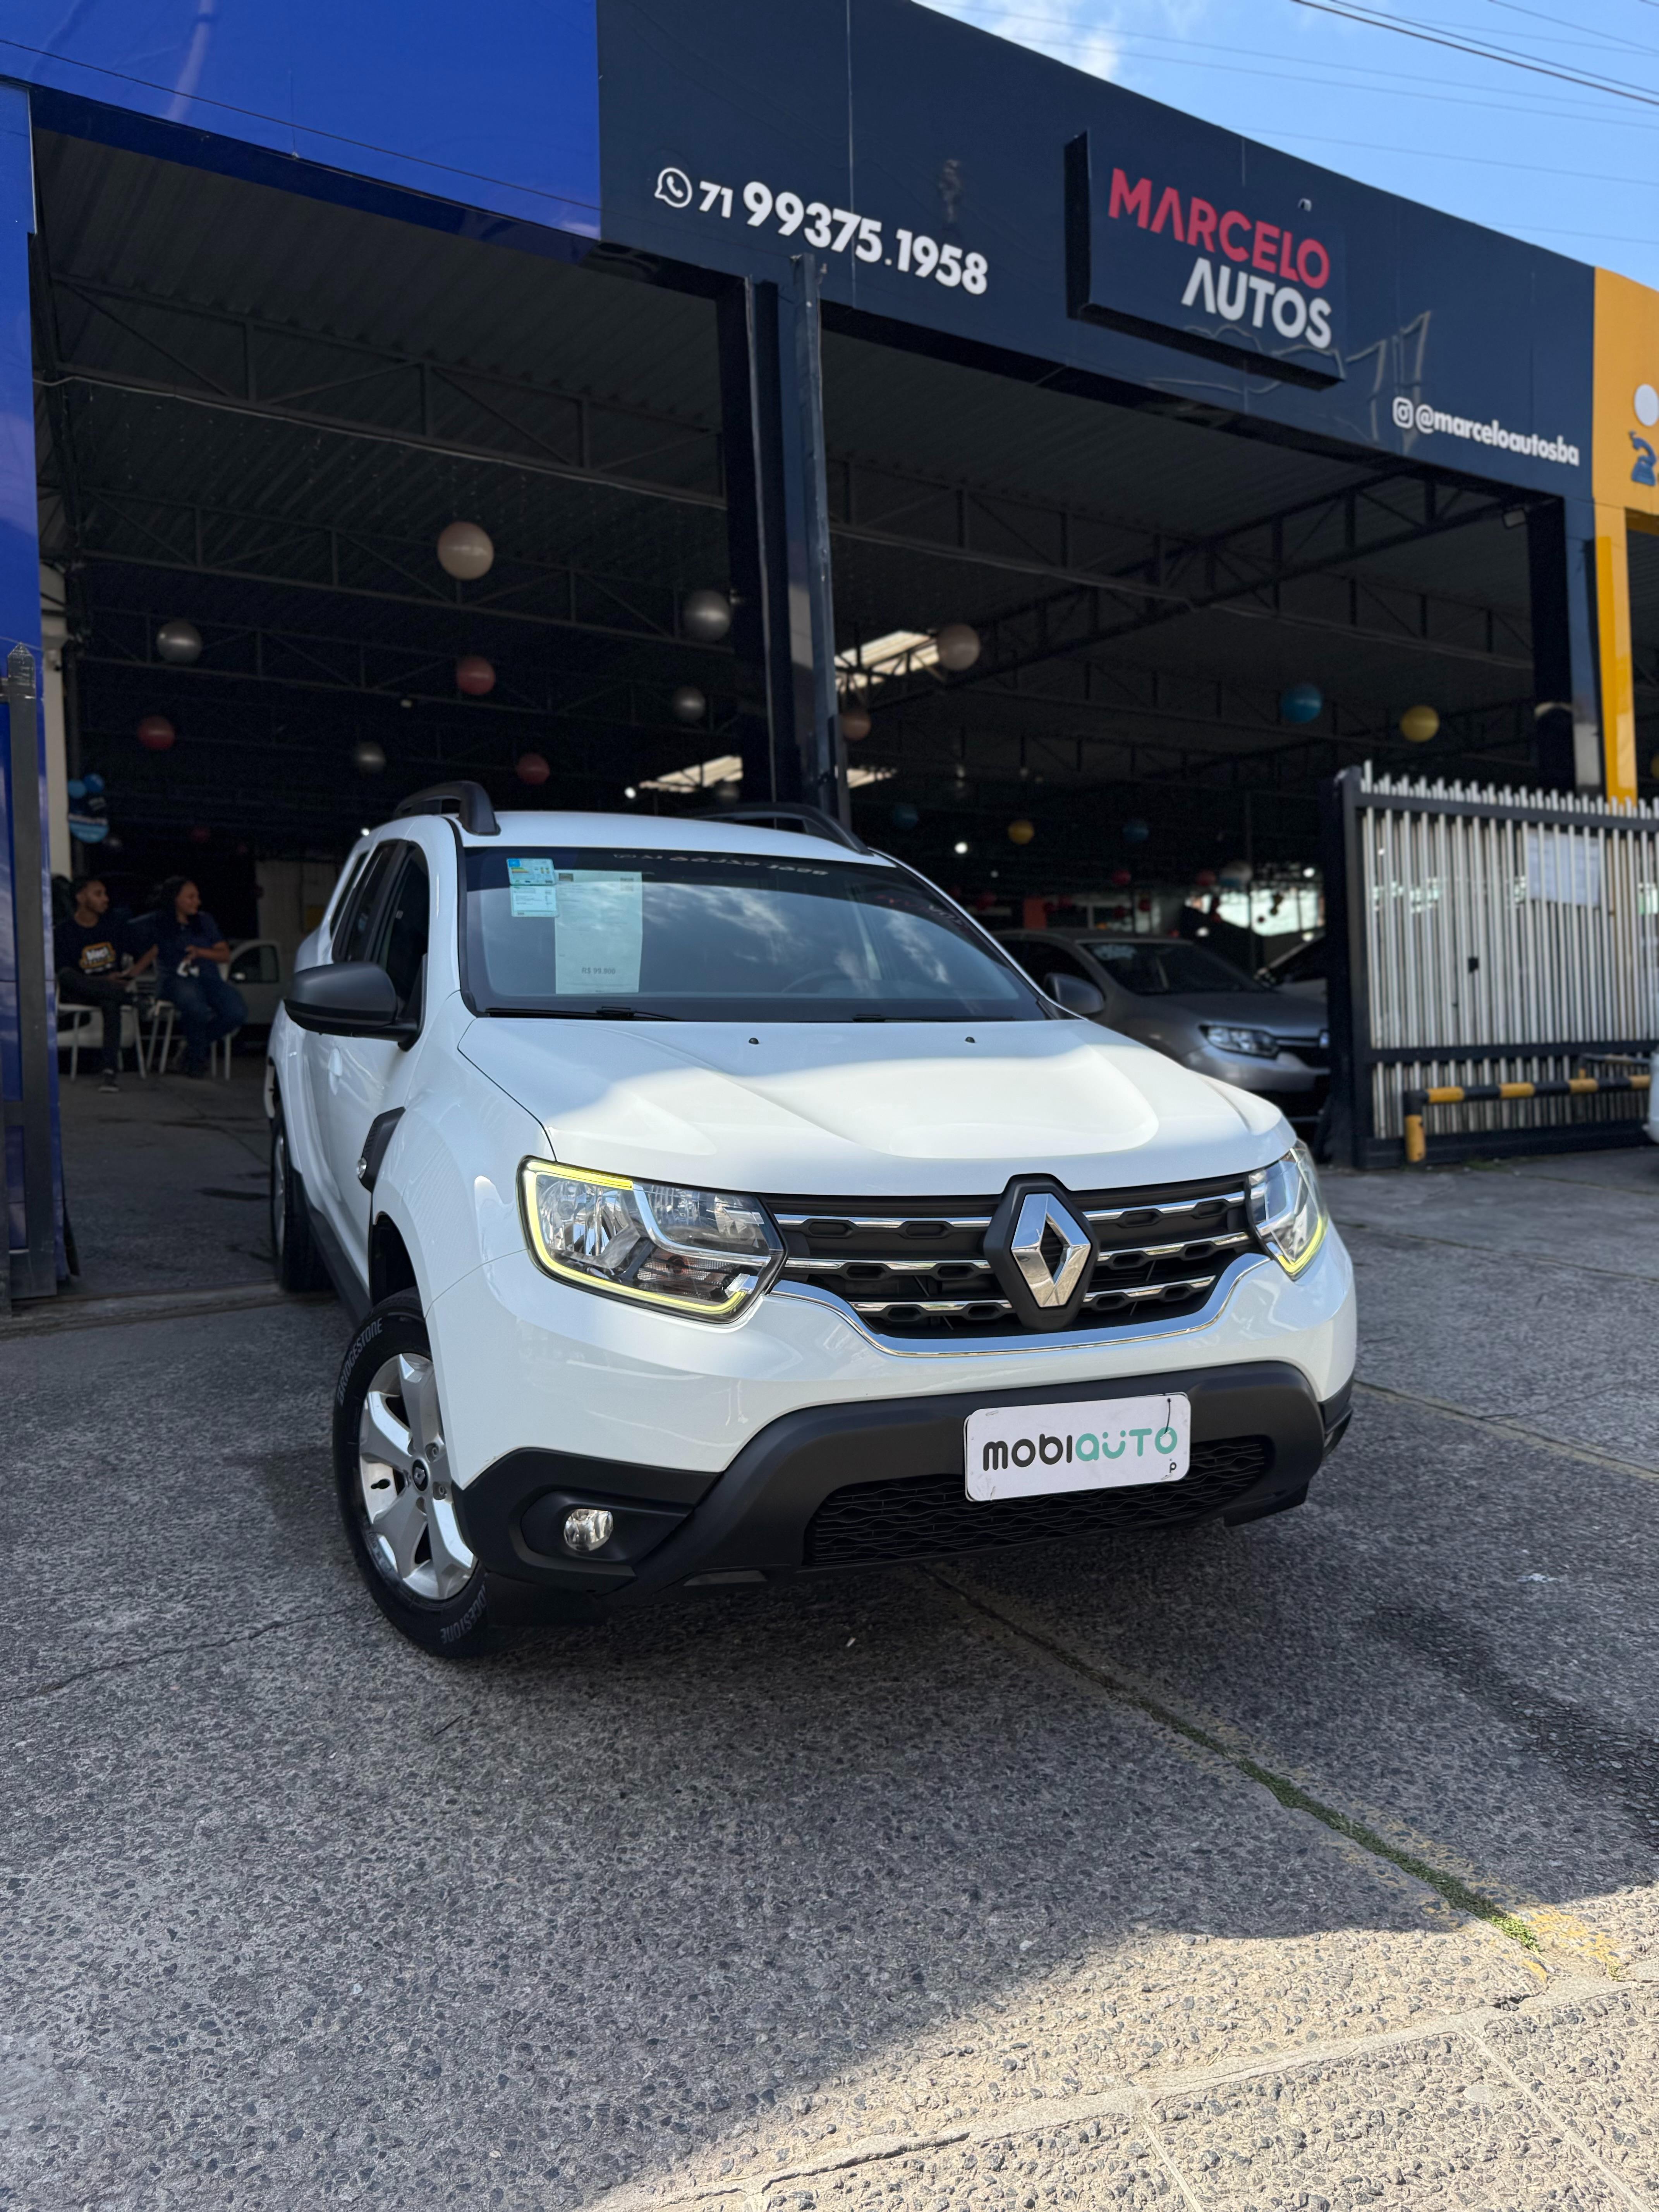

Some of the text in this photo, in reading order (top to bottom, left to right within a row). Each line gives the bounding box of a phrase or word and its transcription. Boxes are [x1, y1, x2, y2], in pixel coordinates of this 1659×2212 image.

[699, 180, 988, 295] 71 99375.1958
[1108, 168, 1330, 289] MARCELO
[1181, 257, 1331, 349] AUTOS
[1415, 404, 1579, 466] @marceloautosba
